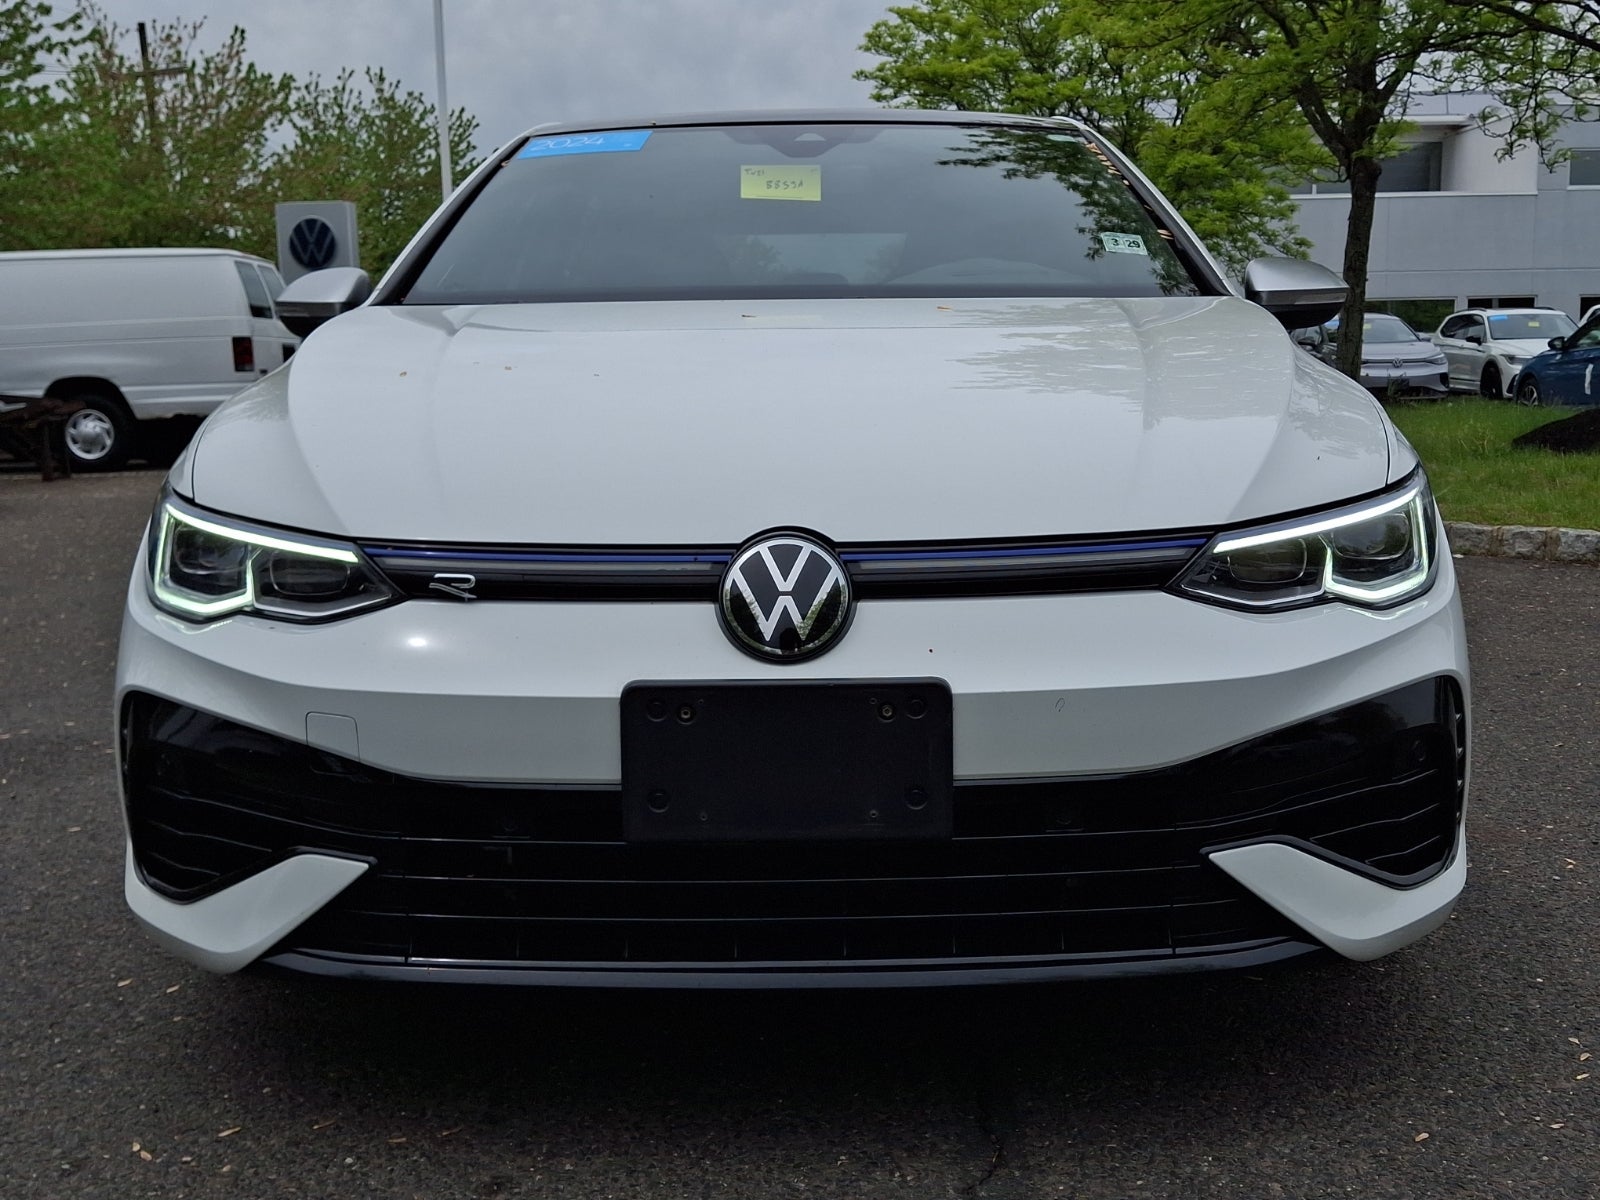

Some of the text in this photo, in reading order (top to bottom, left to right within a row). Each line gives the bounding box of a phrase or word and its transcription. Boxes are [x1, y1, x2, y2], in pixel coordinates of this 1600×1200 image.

[531, 137, 605, 150] 2024
[289, 217, 336, 266] VW
[1111, 238, 1141, 249] 3 29
[728, 542, 844, 643] VW
